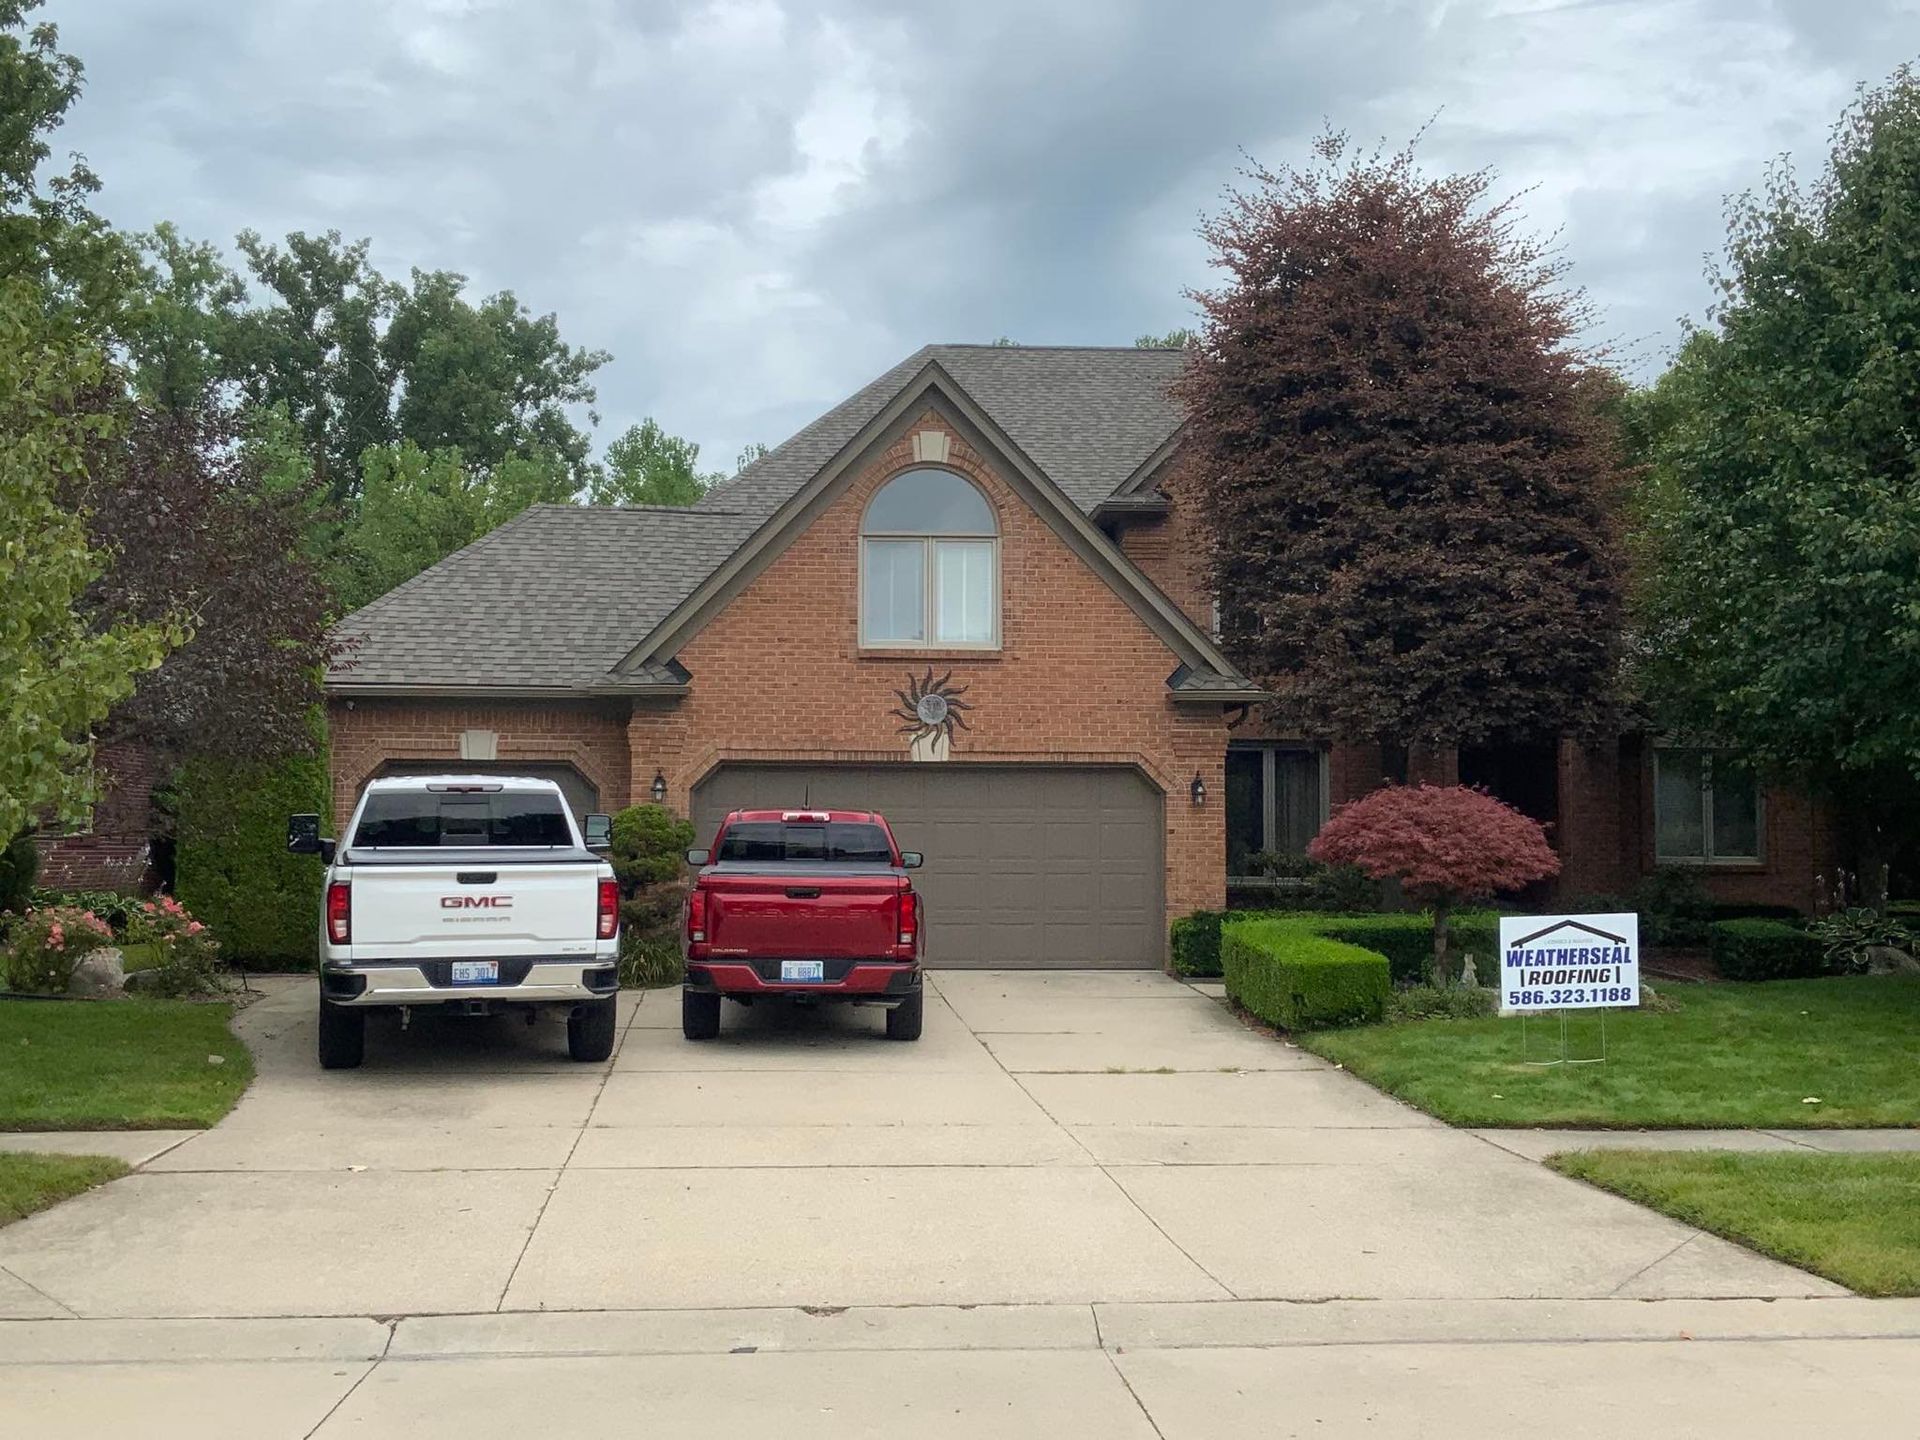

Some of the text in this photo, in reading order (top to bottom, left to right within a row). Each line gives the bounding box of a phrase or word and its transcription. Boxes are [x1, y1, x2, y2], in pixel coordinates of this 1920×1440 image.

[440, 896, 513, 908] GMC
[1506, 946, 1632, 968] WEATHERSEAL
[1527, 968, 1611, 986] ROOFING
[1509, 987, 1632, 1006] 586.323.1188
